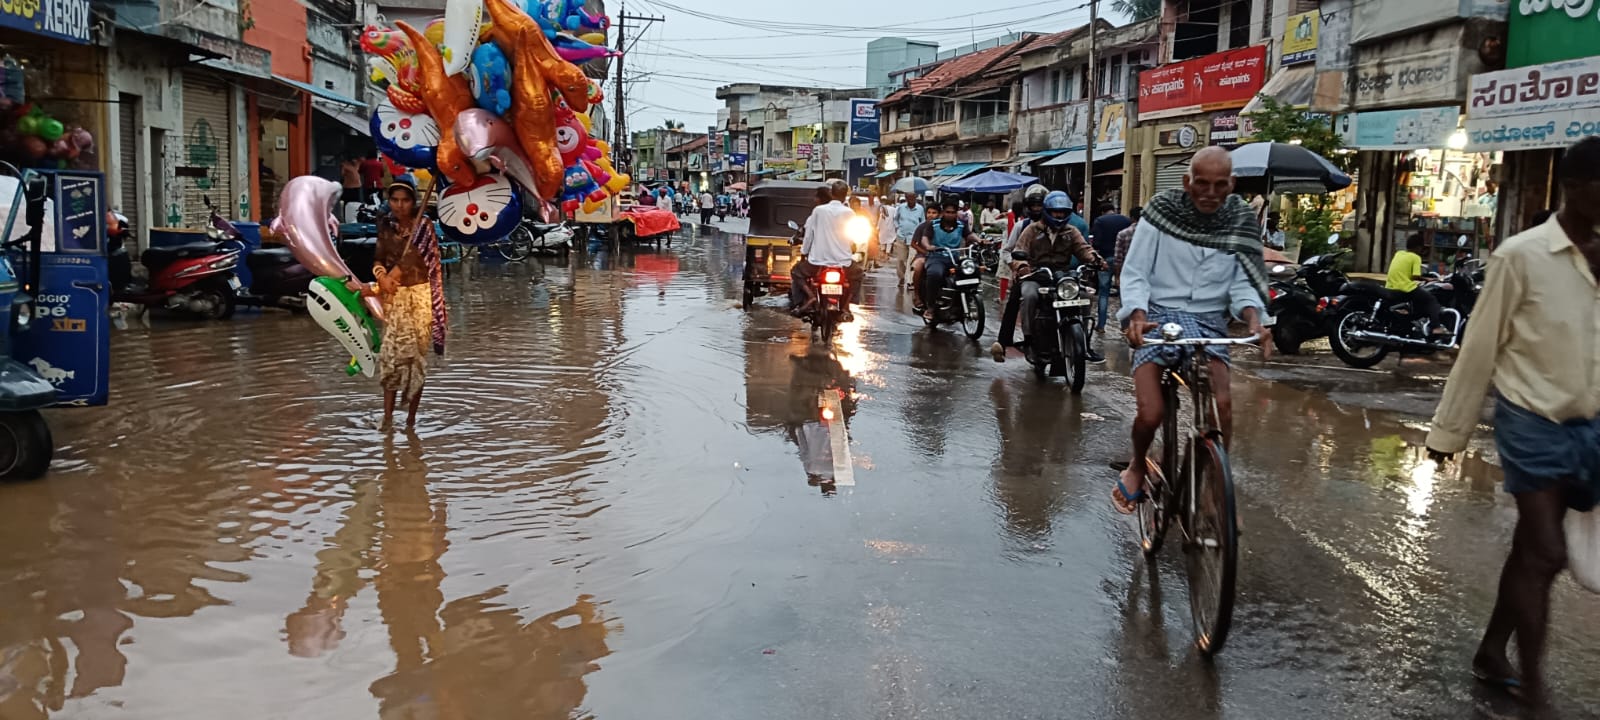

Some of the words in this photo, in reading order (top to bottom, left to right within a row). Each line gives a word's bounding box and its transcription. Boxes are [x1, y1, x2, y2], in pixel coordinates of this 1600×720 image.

[44, 0, 90, 41] XEROX
[1471, 120, 1556, 144] ಸಂತೋಷ್
[35, 294, 69, 303] GGIO
[35, 303, 67, 318] pé
